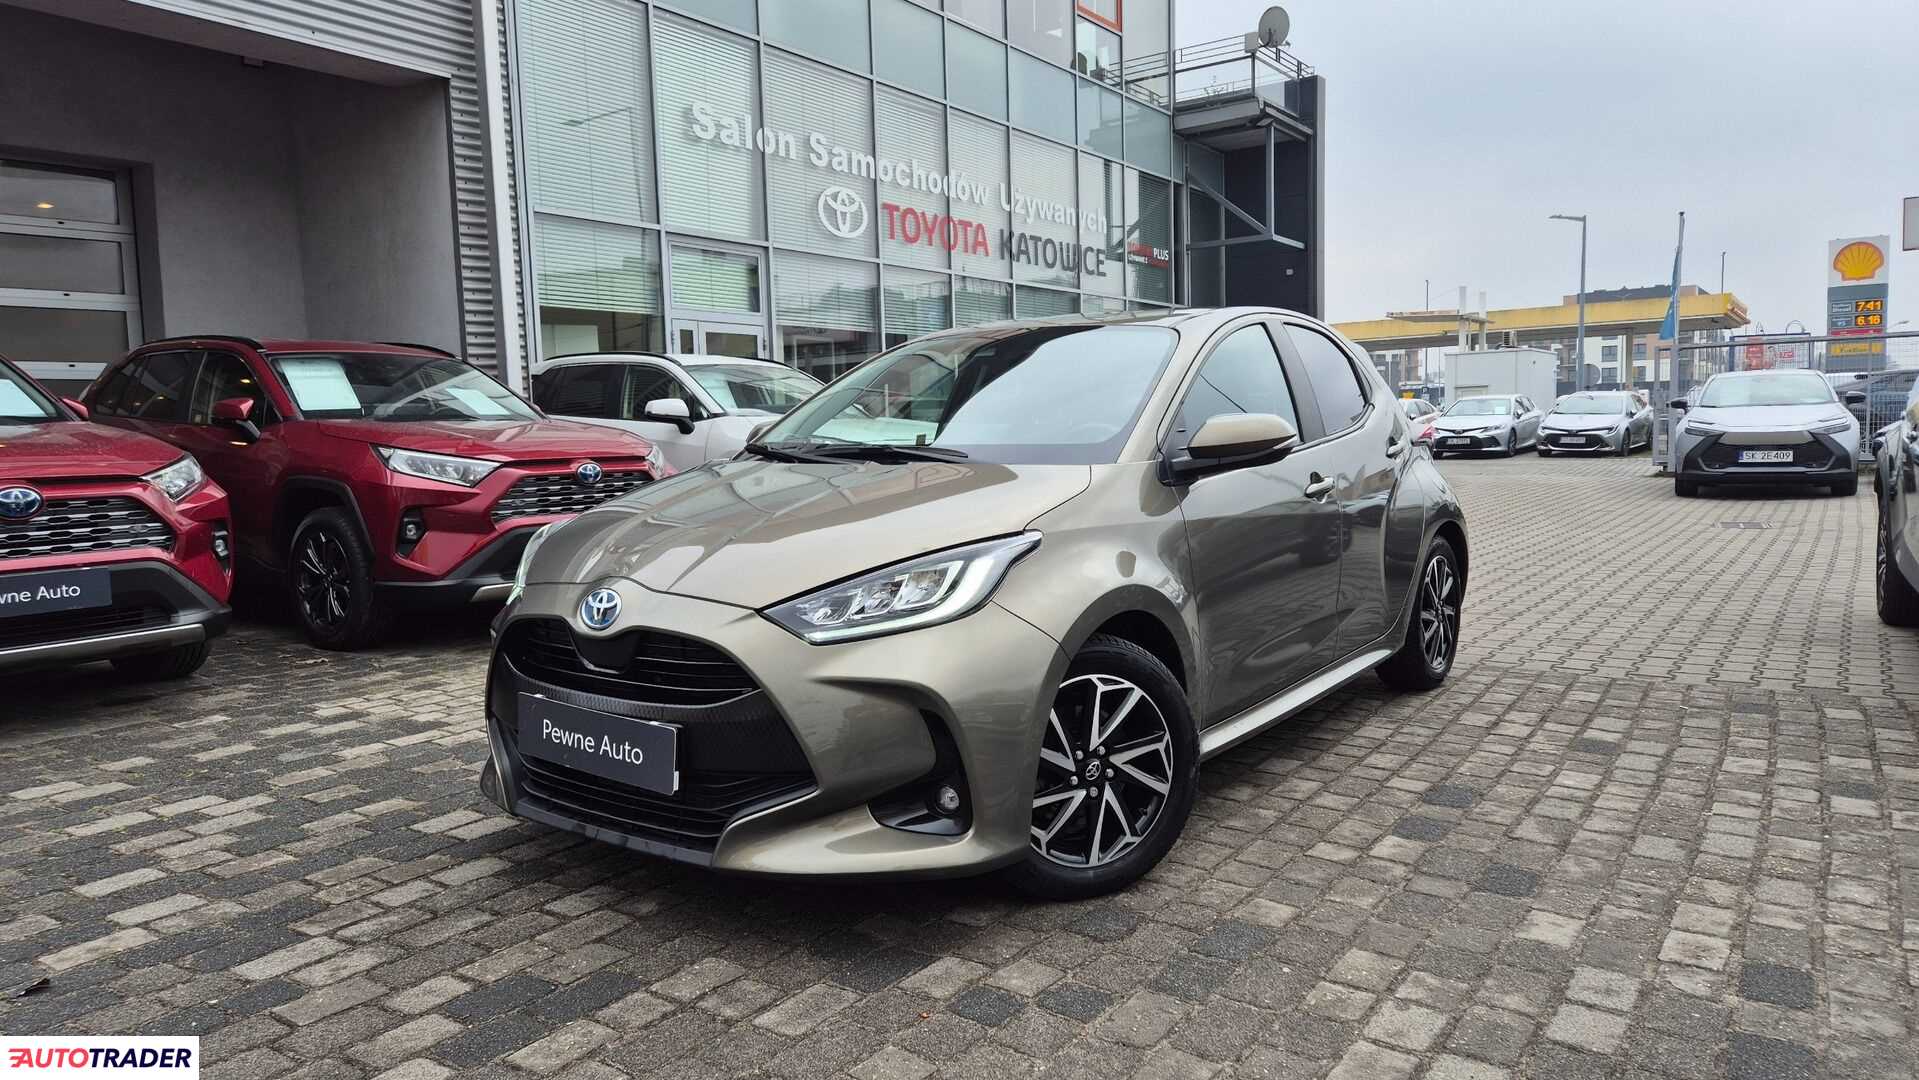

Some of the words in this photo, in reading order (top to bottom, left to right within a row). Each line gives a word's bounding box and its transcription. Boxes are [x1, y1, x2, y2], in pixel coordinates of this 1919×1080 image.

[692, 101, 797, 160] Salon
[809, 132, 989, 205] Samochodów
[1000, 183, 1107, 233] Używanych
[881, 202, 990, 257] TOYOTA
[999, 229, 1107, 276] KATOWICE
[1153, 247, 1169, 260] PLUS
[37, 584, 80, 600] Auto
[543, 718, 595, 752] Pewne
[600, 735, 643, 765] Auto
